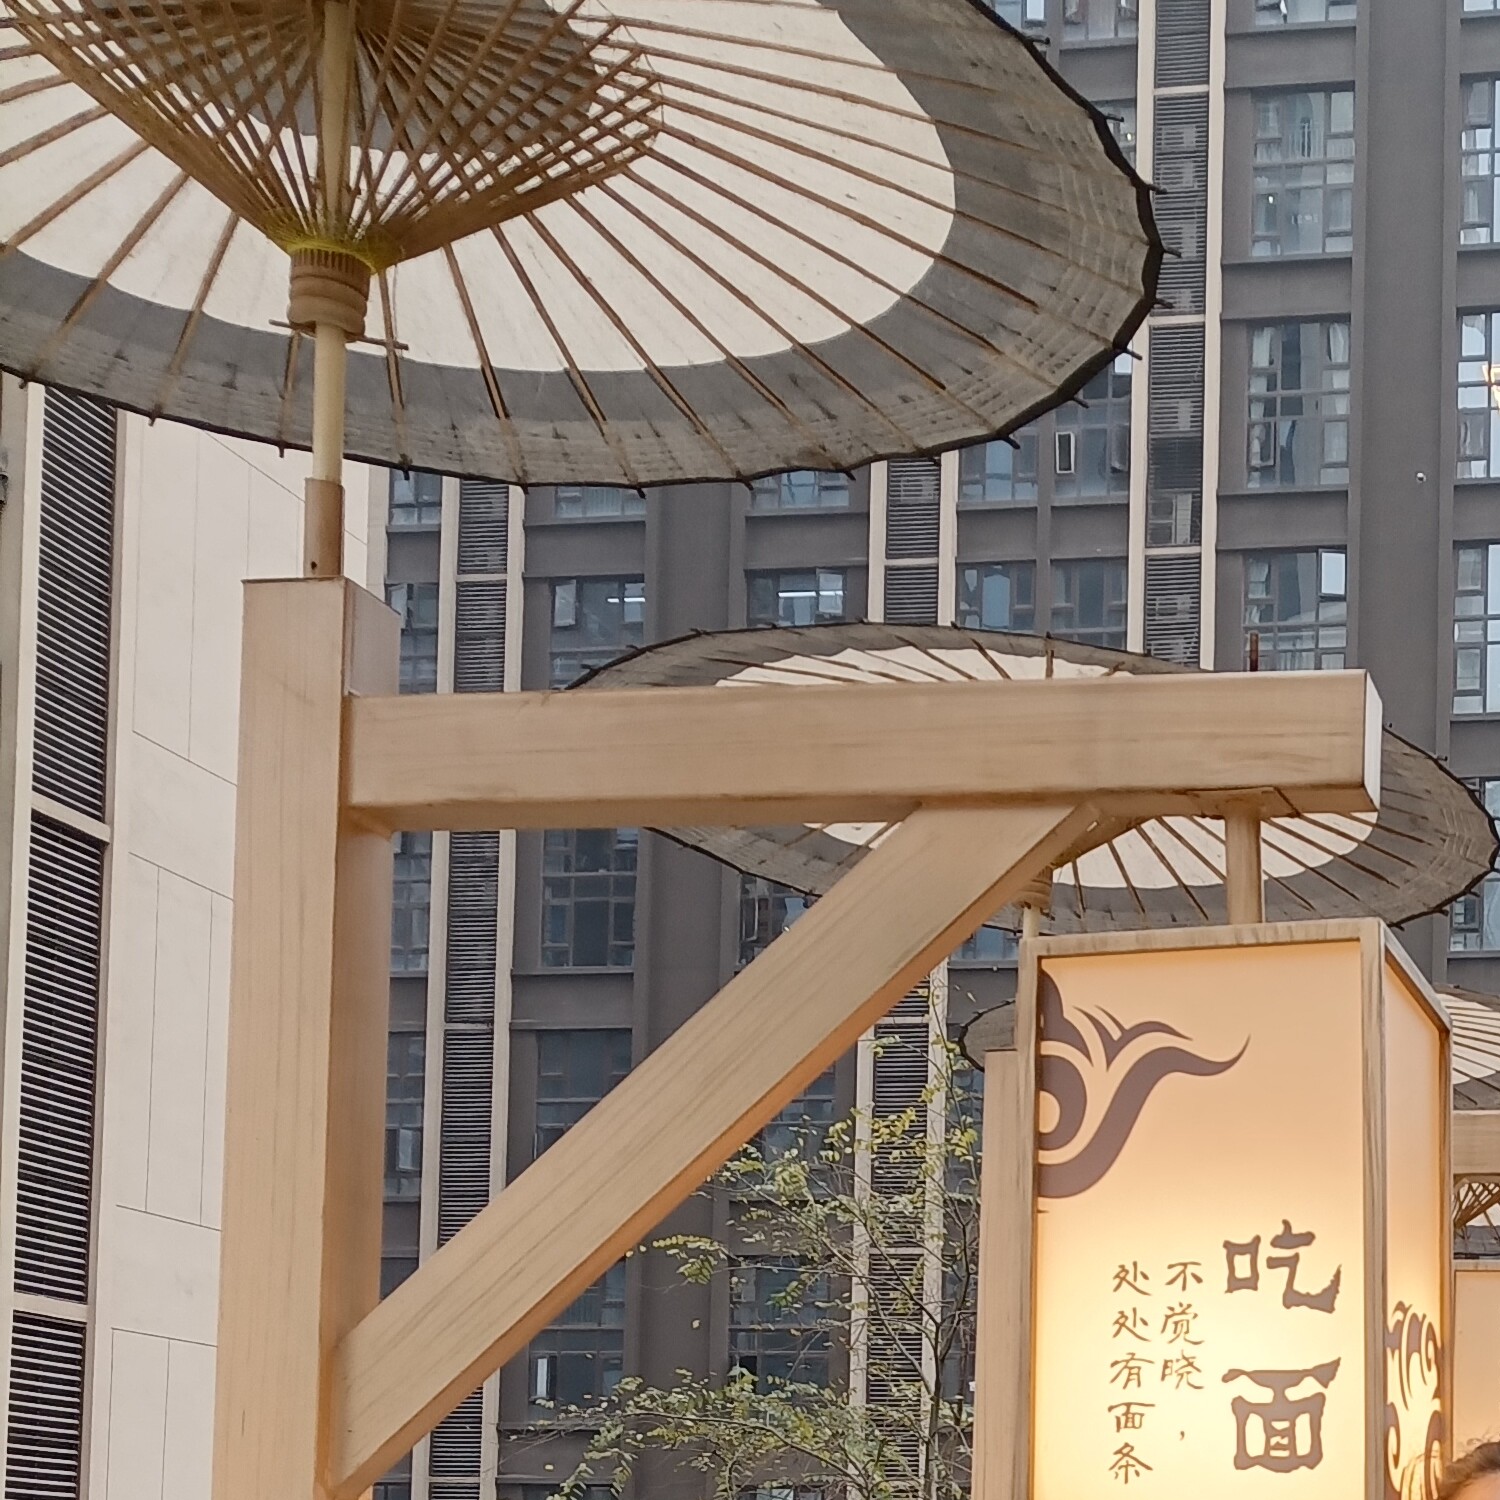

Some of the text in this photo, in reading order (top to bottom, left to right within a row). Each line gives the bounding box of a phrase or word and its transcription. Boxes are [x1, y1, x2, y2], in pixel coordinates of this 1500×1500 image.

[1107, 1260, 1156, 1484] 处处有面条
[1221, 1219, 1342, 1473] 吃面
